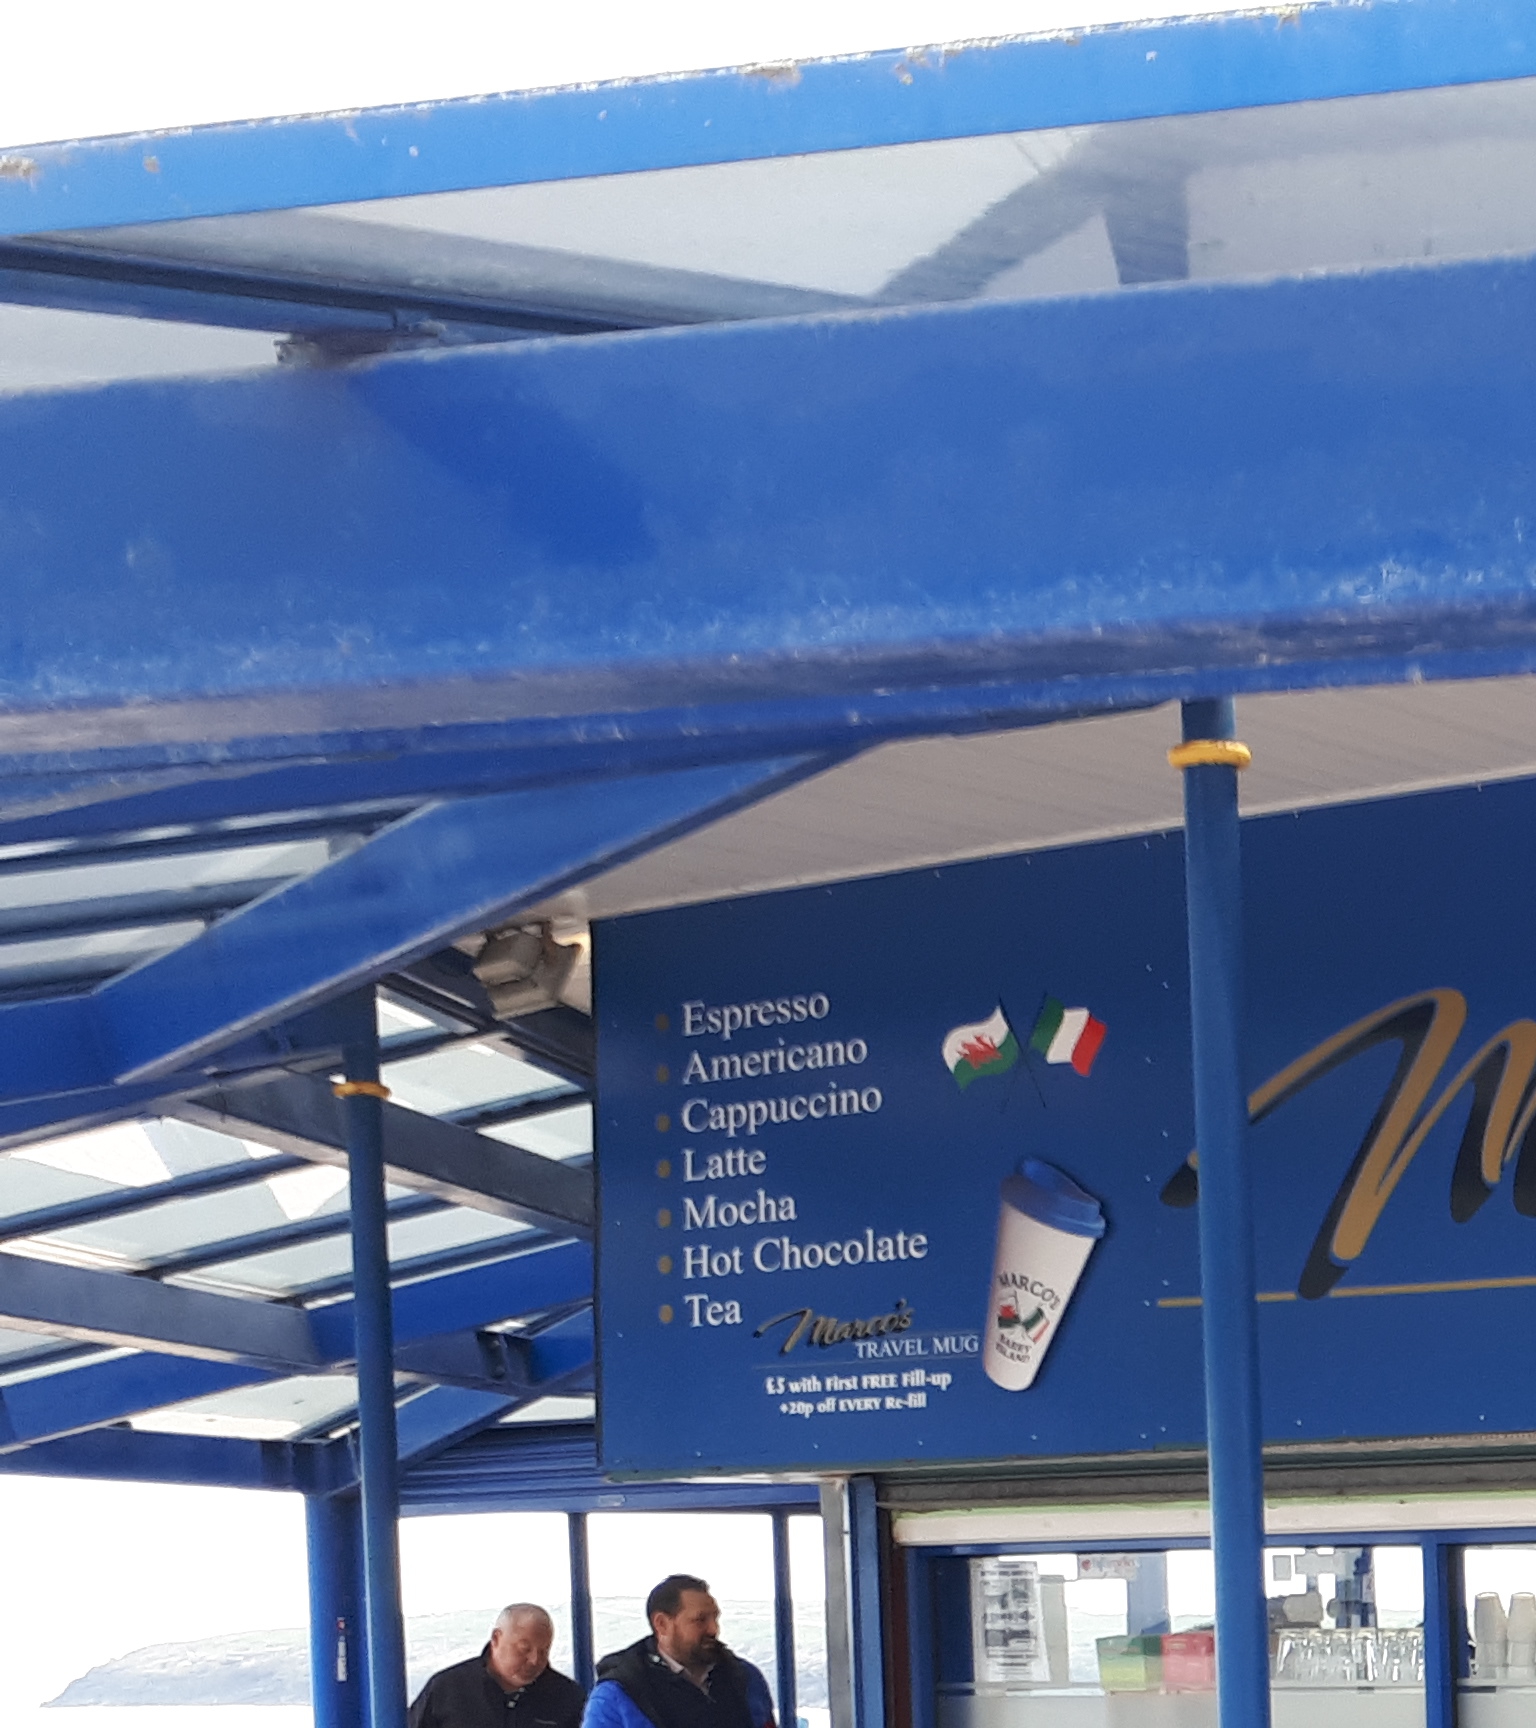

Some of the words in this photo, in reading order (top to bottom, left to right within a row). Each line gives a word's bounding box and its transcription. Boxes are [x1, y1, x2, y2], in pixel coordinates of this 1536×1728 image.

[682, 992, 830, 1040] Espresso
[682, 1037, 868, 1085] Americano
[681, 1081, 882, 1138] Cappuccino
[682, 1147, 767, 1182] Latte
[683, 1188, 797, 1231] Mocha
[683, 1243, 744, 1279] Hot
[754, 1226, 929, 1273] Chocolate
[684, 1293, 744, 1328] Tea
[753, 1299, 914, 1354] Marco's
[855, 1339, 928, 1359] TRAVEL
[934, 1334, 979, 1355] MUG
[766, 1376, 786, 1395] £5
[788, 1374, 822, 1394] with
[825, 1374, 858, 1392] First
[861, 1372, 899, 1390] FREE
[902, 1369, 952, 1392] Fill-up
[780, 1400, 814, 1418] +20p
[817, 1398, 836, 1413] off
[839, 1396, 882, 1412] EVERY
[885, 1392, 927, 1409] Re-fill
